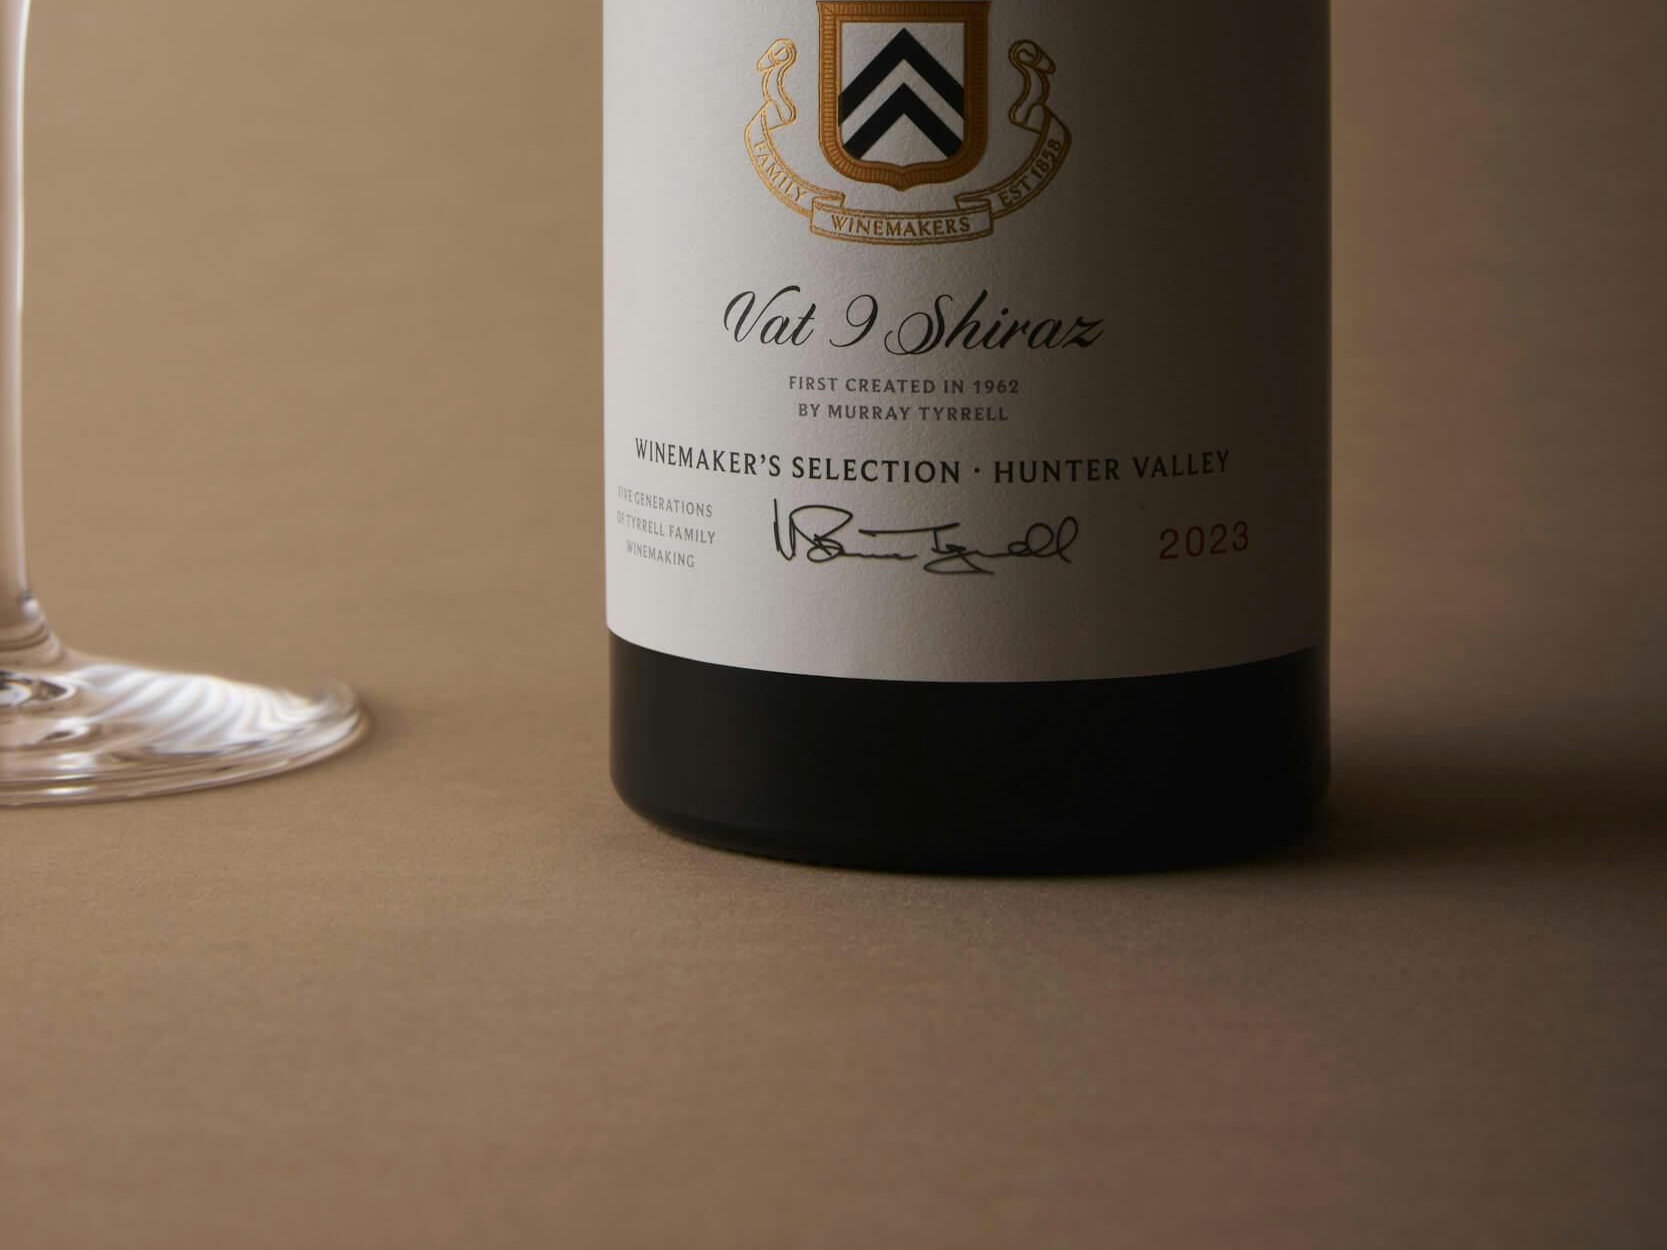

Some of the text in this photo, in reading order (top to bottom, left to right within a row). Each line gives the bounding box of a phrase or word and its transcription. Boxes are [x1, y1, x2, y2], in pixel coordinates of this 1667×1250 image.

[753, 140, 807, 202] FAMILY
[998, 138, 1062, 207] EST 1858
[831, 214, 971, 237] WINEMAKERS
[723, 285, 1104, 356] Vat 9 Shiraz
[788, 375, 1020, 395] FIRST CREATED IN 1962
[798, 403, 1009, 422] BY MURRAY TYRRELL
[635, 437, 1230, 484] WINEMAKER’S SELECTION HUNTER VALLEY
[634, 491, 713, 518] GENERATIONS
[626, 514, 665, 537] TYRRELL
[669, 524, 716, 545] FAMILY
[1158, 520, 1249, 560] 2023
[626, 539, 695, 568] WINEMAKING
